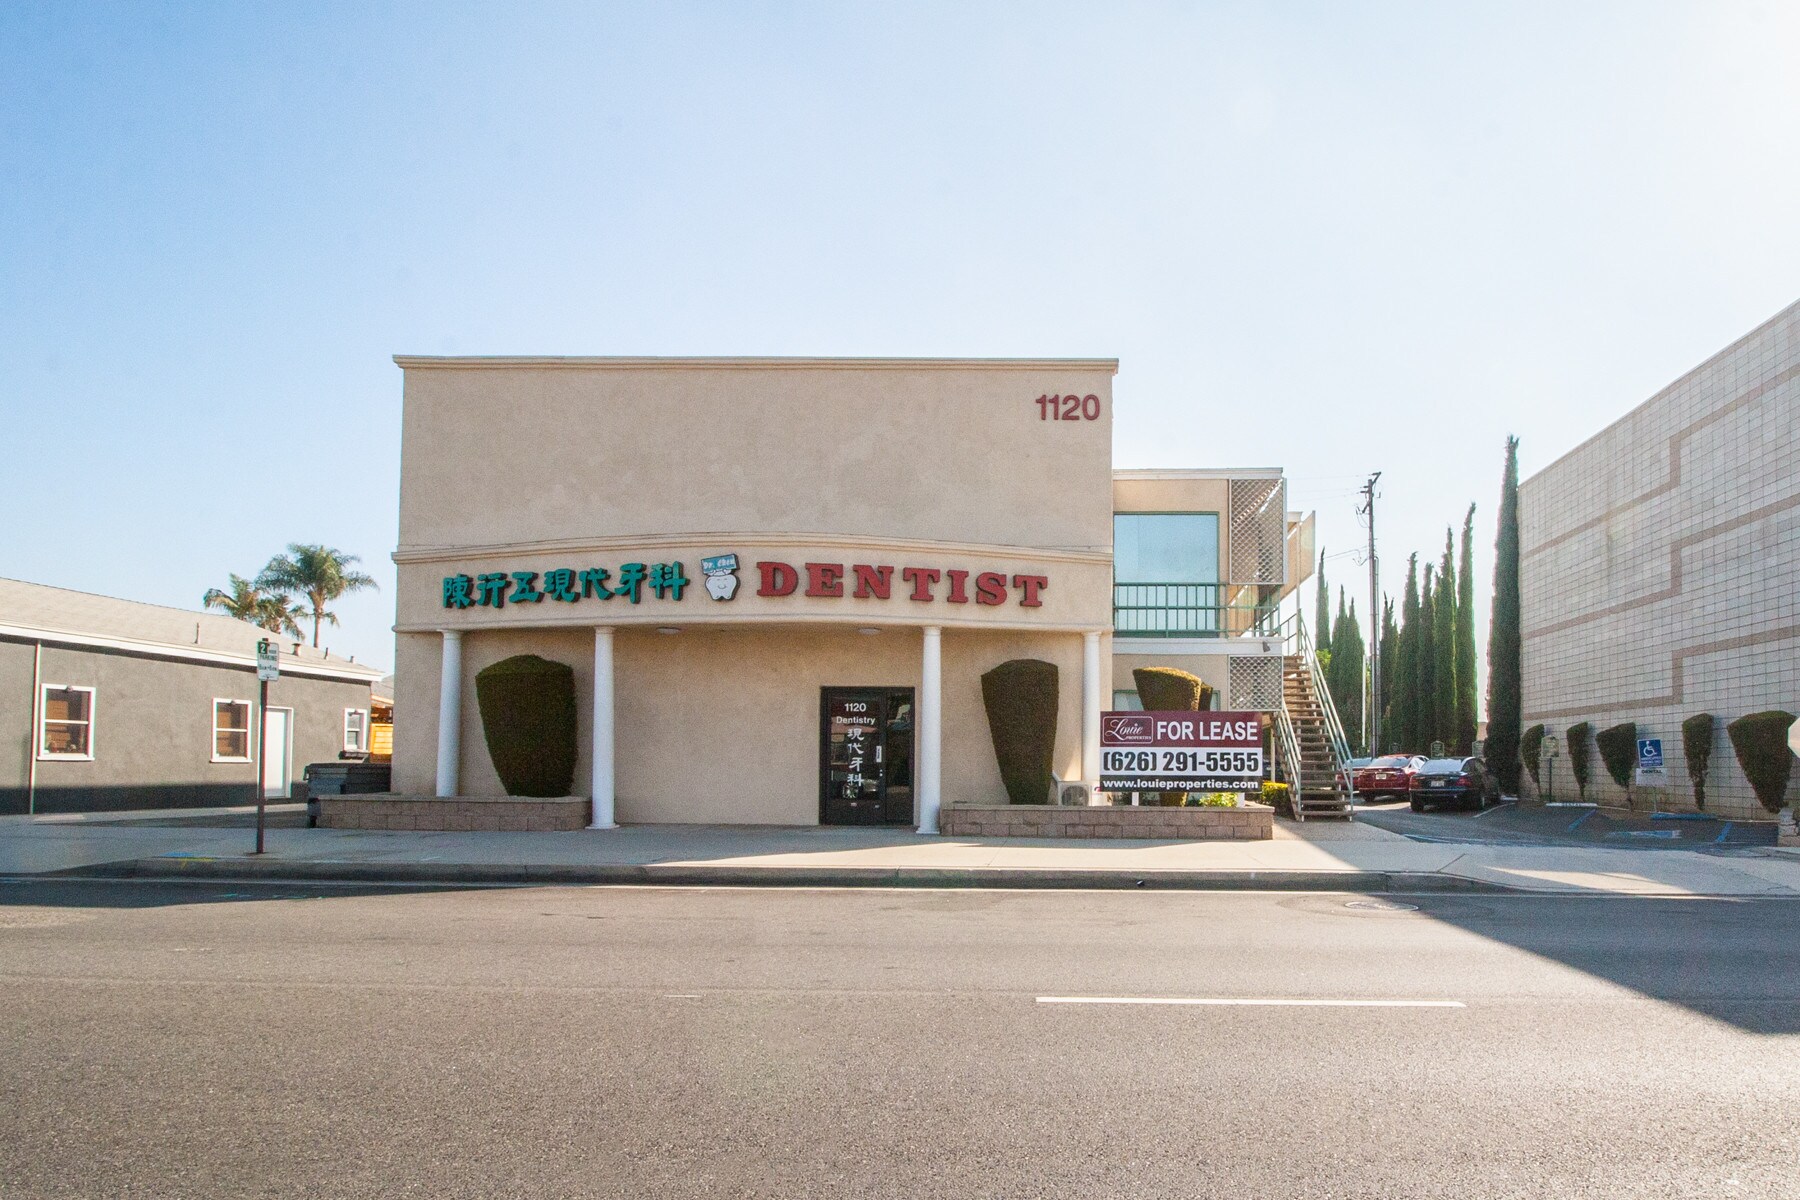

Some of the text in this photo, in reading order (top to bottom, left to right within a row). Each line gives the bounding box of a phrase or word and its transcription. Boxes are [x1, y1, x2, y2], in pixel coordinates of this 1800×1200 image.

[1035, 394, 1100, 421] 1120
[442, 560, 688, 609] 陳行五現代牙科
[756, 561, 1048, 607] DENTIST
[260, 644, 266, 653] 2
[844, 702, 867, 712] 1120
[836, 715, 876, 726] Dentistry
[1105, 718, 1144, 740] Louie
[1156, 721, 1258, 741] FOR LEASE
[847, 728, 865, 787] 現代牙科
[1103, 751, 1259, 772] (626) 291-5555
[1103, 778, 1259, 790] www.louieproperties.com
